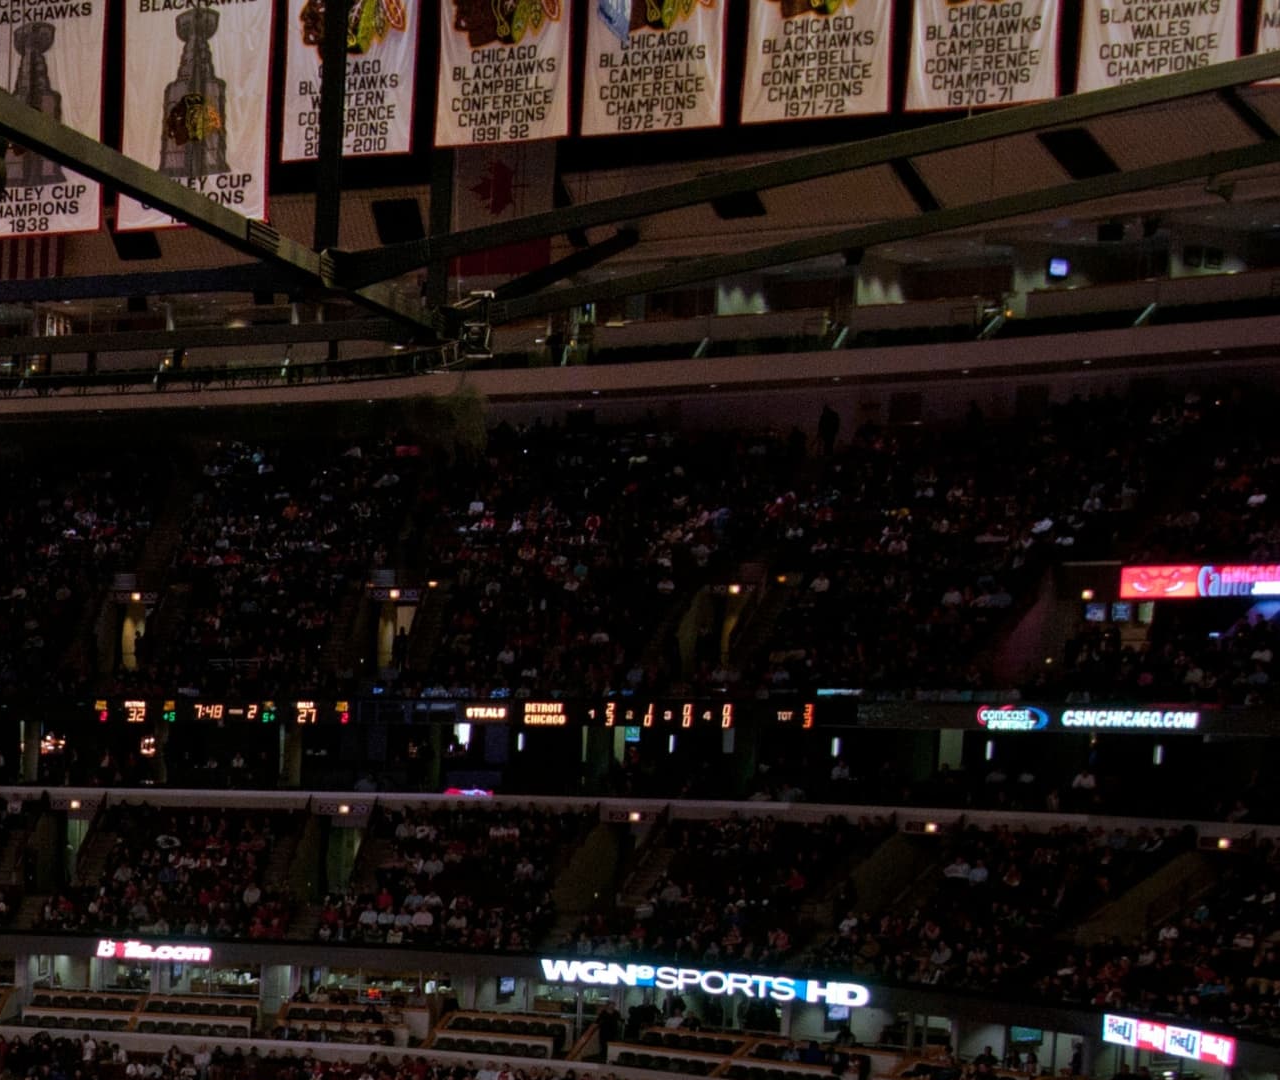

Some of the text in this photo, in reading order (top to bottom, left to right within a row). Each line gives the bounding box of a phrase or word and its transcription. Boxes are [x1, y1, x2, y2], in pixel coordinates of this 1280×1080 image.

[948, 2, 1022, 22] CHICAGO
[1099, 2, 1221, 25] BLACKHAWKS
[783, 16, 854, 36] CHICAGO
[926, 16, 1042, 41] BLACKHAWKS
[1131, 21, 1190, 40] WALES
[621, 31, 689, 51] CHICAGO
[762, 30, 874, 54] BLACKHAWKS
[936, 36, 1030, 57] CAMPBELL
[1099, 33, 1219, 60] CONFERENCE
[470, 45, 537, 64] CHICAGO
[599, 45, 706, 69] BLACKHAWKS
[771, 49, 862, 70] CAMPBELL
[925, 50, 1040, 75] CONFERENCE
[452, 57, 556, 82] BLACKHAWKS
[609, 63, 696, 84] CAMPBELL
[761, 62, 872, 87] CONFERENCE
[932, 68, 1031, 91] CHAMPIONS
[461, 76, 545, 97] CAMPBELL
[599, 77, 705, 101] CONFERENCE
[767, 81, 864, 102] CHAMPIONS
[947, 87, 1014, 106] 1970-71
[451, 89, 553, 113] CONFERENCE
[606, 94, 697, 116] CHAMPIONS
[784, 98, 846, 118] 1971-72
[457, 107, 546, 128] CHAMPIONS
[617, 111, 684, 131] 1972-73
[471, 124, 530, 142] 1991-92
[51, 184, 87, 199] CUP
[9, 218, 49, 233] 1938
[127, 708, 146, 722] 32
[194, 704, 223, 719] 7:48
[297, 708, 317, 723] 27
[466, 707, 506, 719] STEALS
[524, 713, 566, 725] CHICAGO
[525, 703, 562, 714] DETROIT
[1061, 709, 1199, 729] CSNCHICAGO.COM
[654, 966, 796, 1002] SPORTS
[805, 980, 870, 1008] HD
